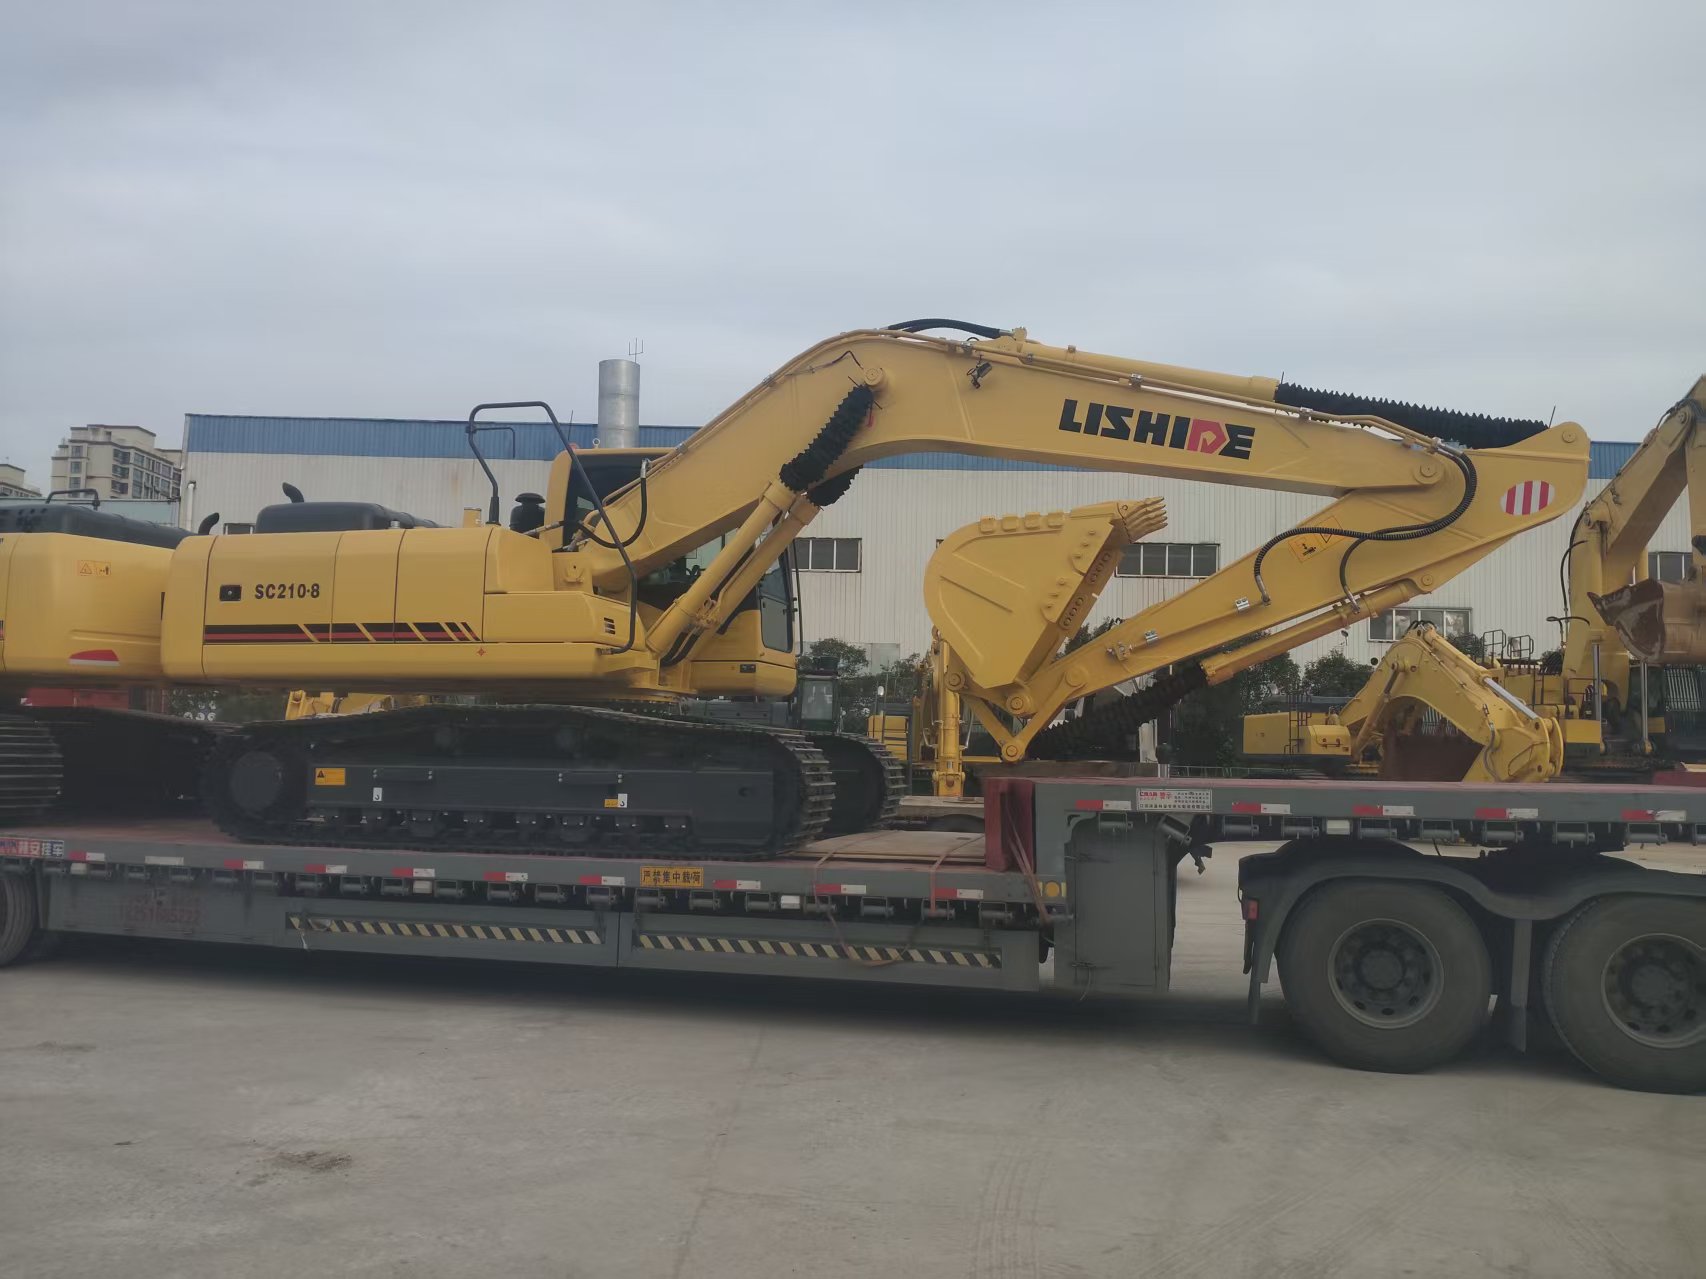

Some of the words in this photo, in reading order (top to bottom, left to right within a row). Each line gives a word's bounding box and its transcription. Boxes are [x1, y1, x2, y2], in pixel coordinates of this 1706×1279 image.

[1058, 398, 1255, 460] LISHIDE
[643, 869, 701, 885] 严禁集中载荷
